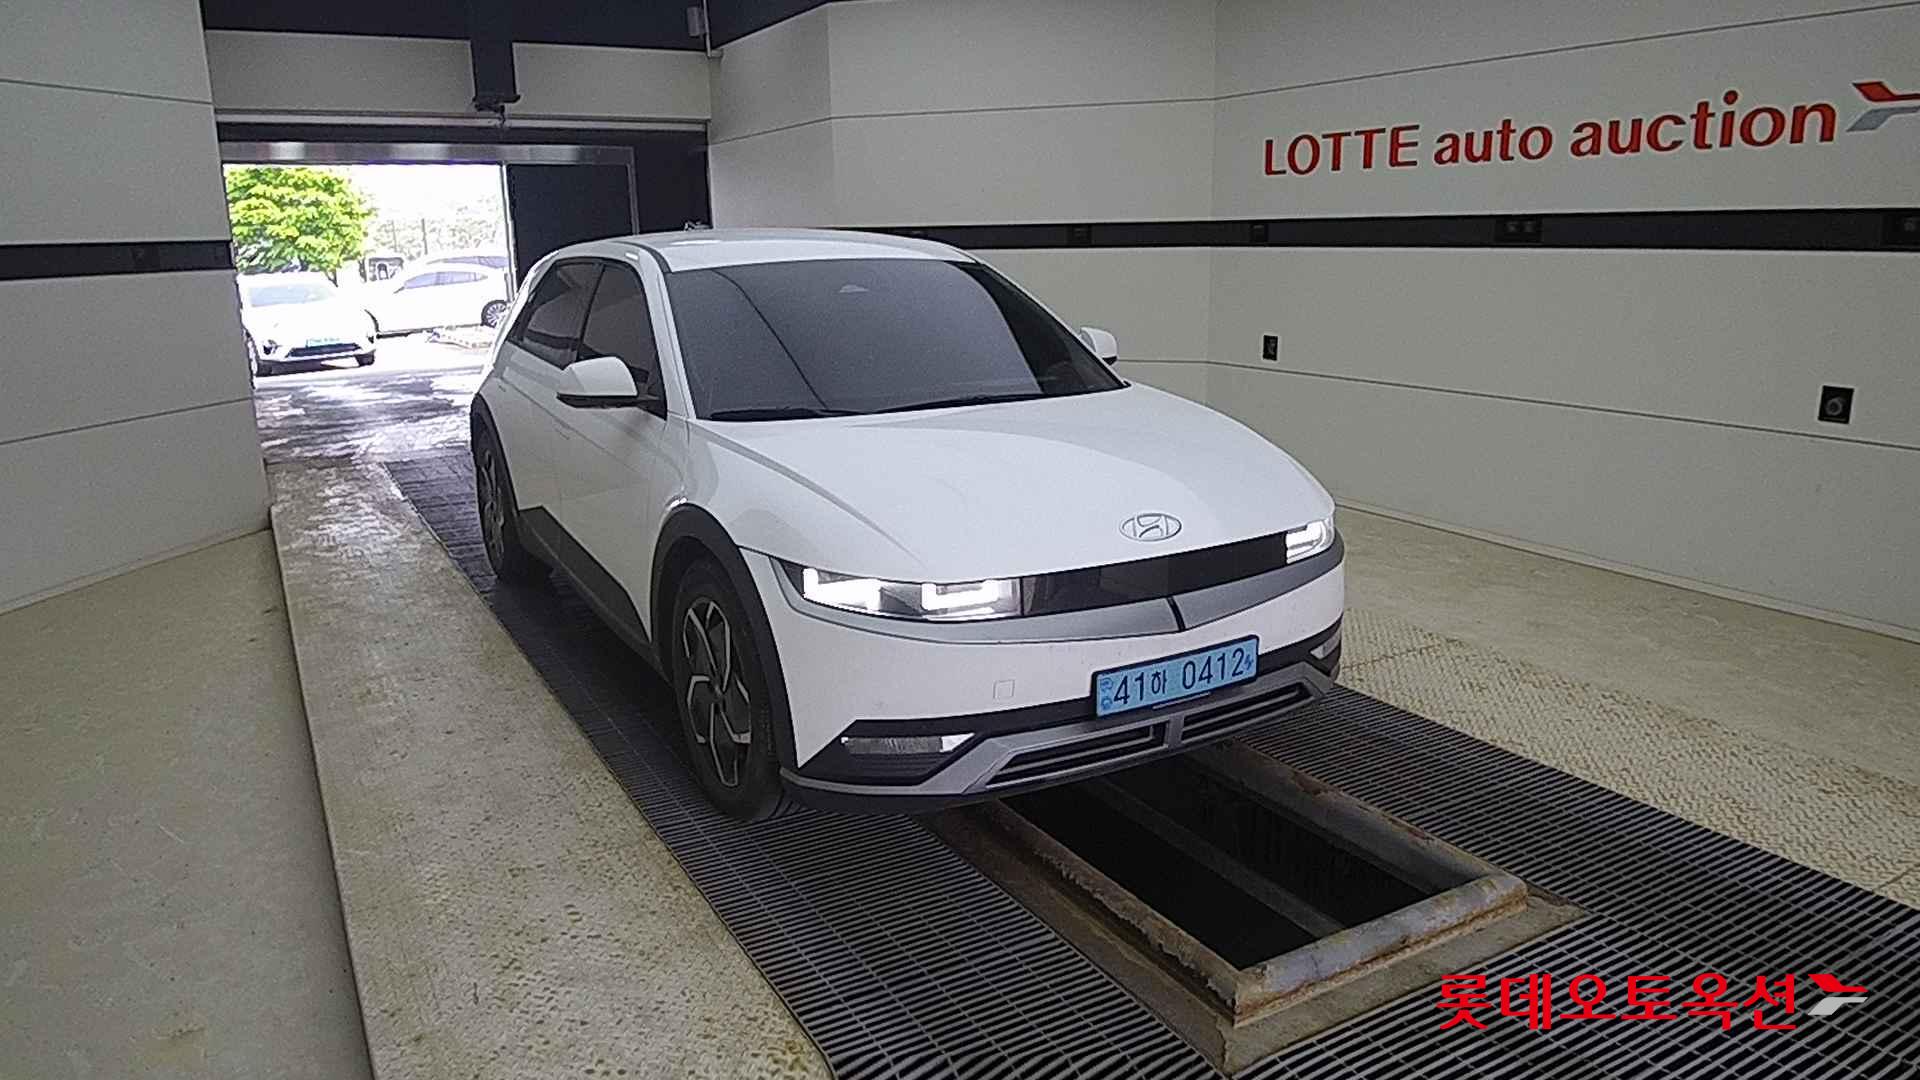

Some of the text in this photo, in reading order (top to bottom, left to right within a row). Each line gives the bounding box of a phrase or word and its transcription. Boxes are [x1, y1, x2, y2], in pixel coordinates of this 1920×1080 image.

[1264, 90, 1837, 175] LOTTE auto auction
[1114, 648, 1244, 704] 41하 0412
